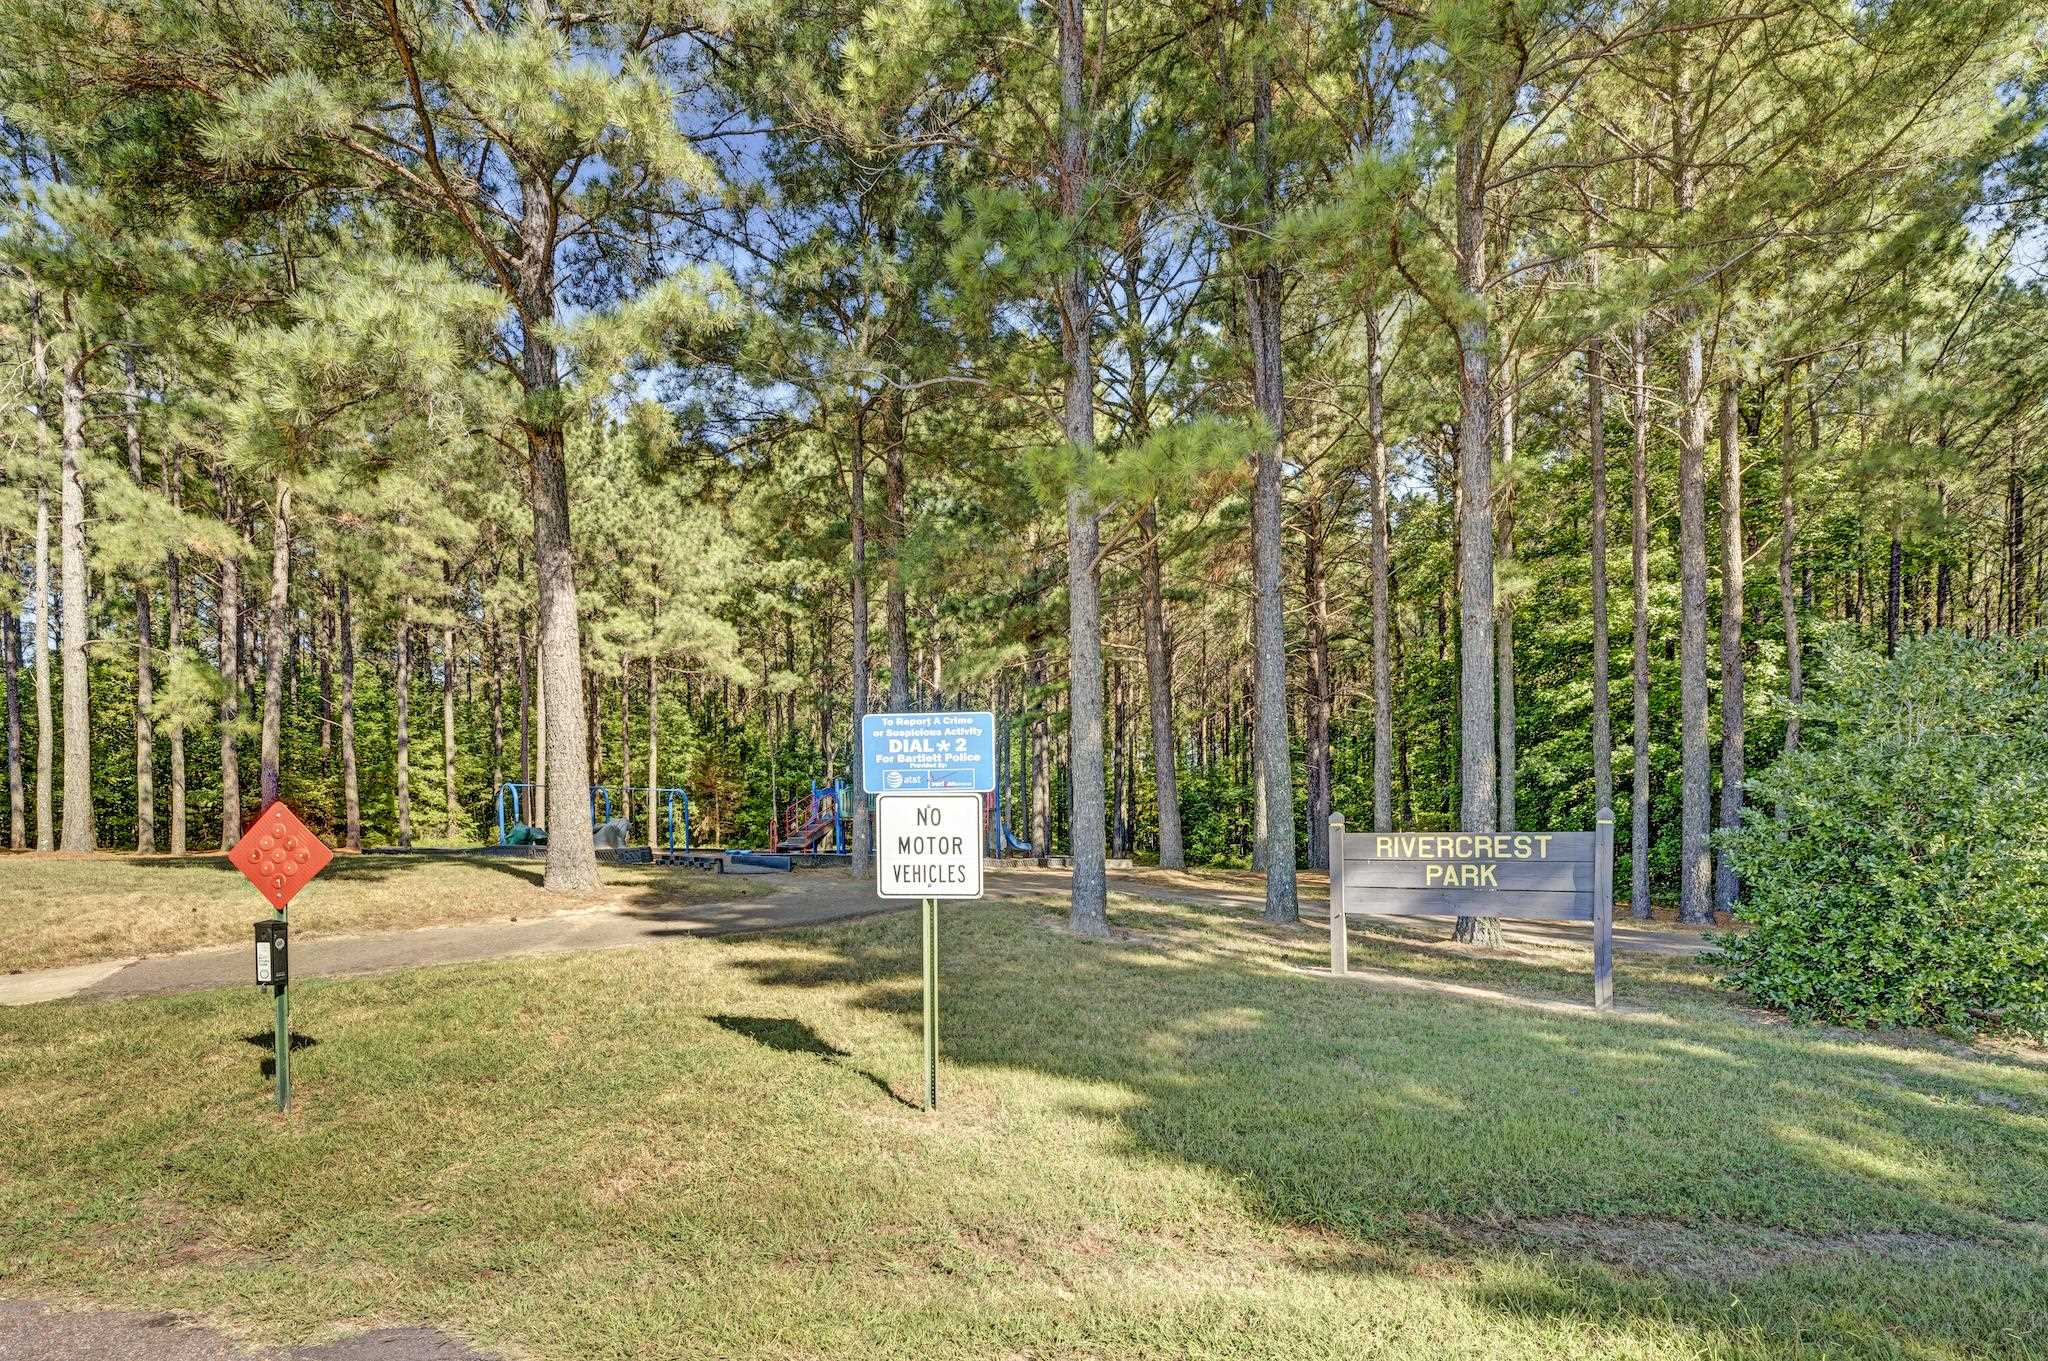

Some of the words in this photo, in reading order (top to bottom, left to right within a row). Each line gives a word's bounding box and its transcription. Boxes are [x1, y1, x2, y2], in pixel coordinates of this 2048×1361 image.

[882, 718, 893, 726] To
[896, 717, 932, 727] Report
[934, 717, 941, 725] A
[943, 716, 973, 725] Crime
[886, 729, 942, 738] Suspicious
[944, 727, 983, 736] Activity
[889, 739, 934, 753] DIAL
[955, 738, 967, 752] 2
[876, 754, 894, 763] For
[897, 753, 942, 763] Bartlett
[945, 753, 981, 762] Police
[917, 808, 941, 826] NO
[898, 836, 962, 855] MOTOR
[1376, 835, 1552, 858] RIVERCREST
[893, 865, 966, 883] VEHICLES
[1426, 865, 1498, 887] PARK
